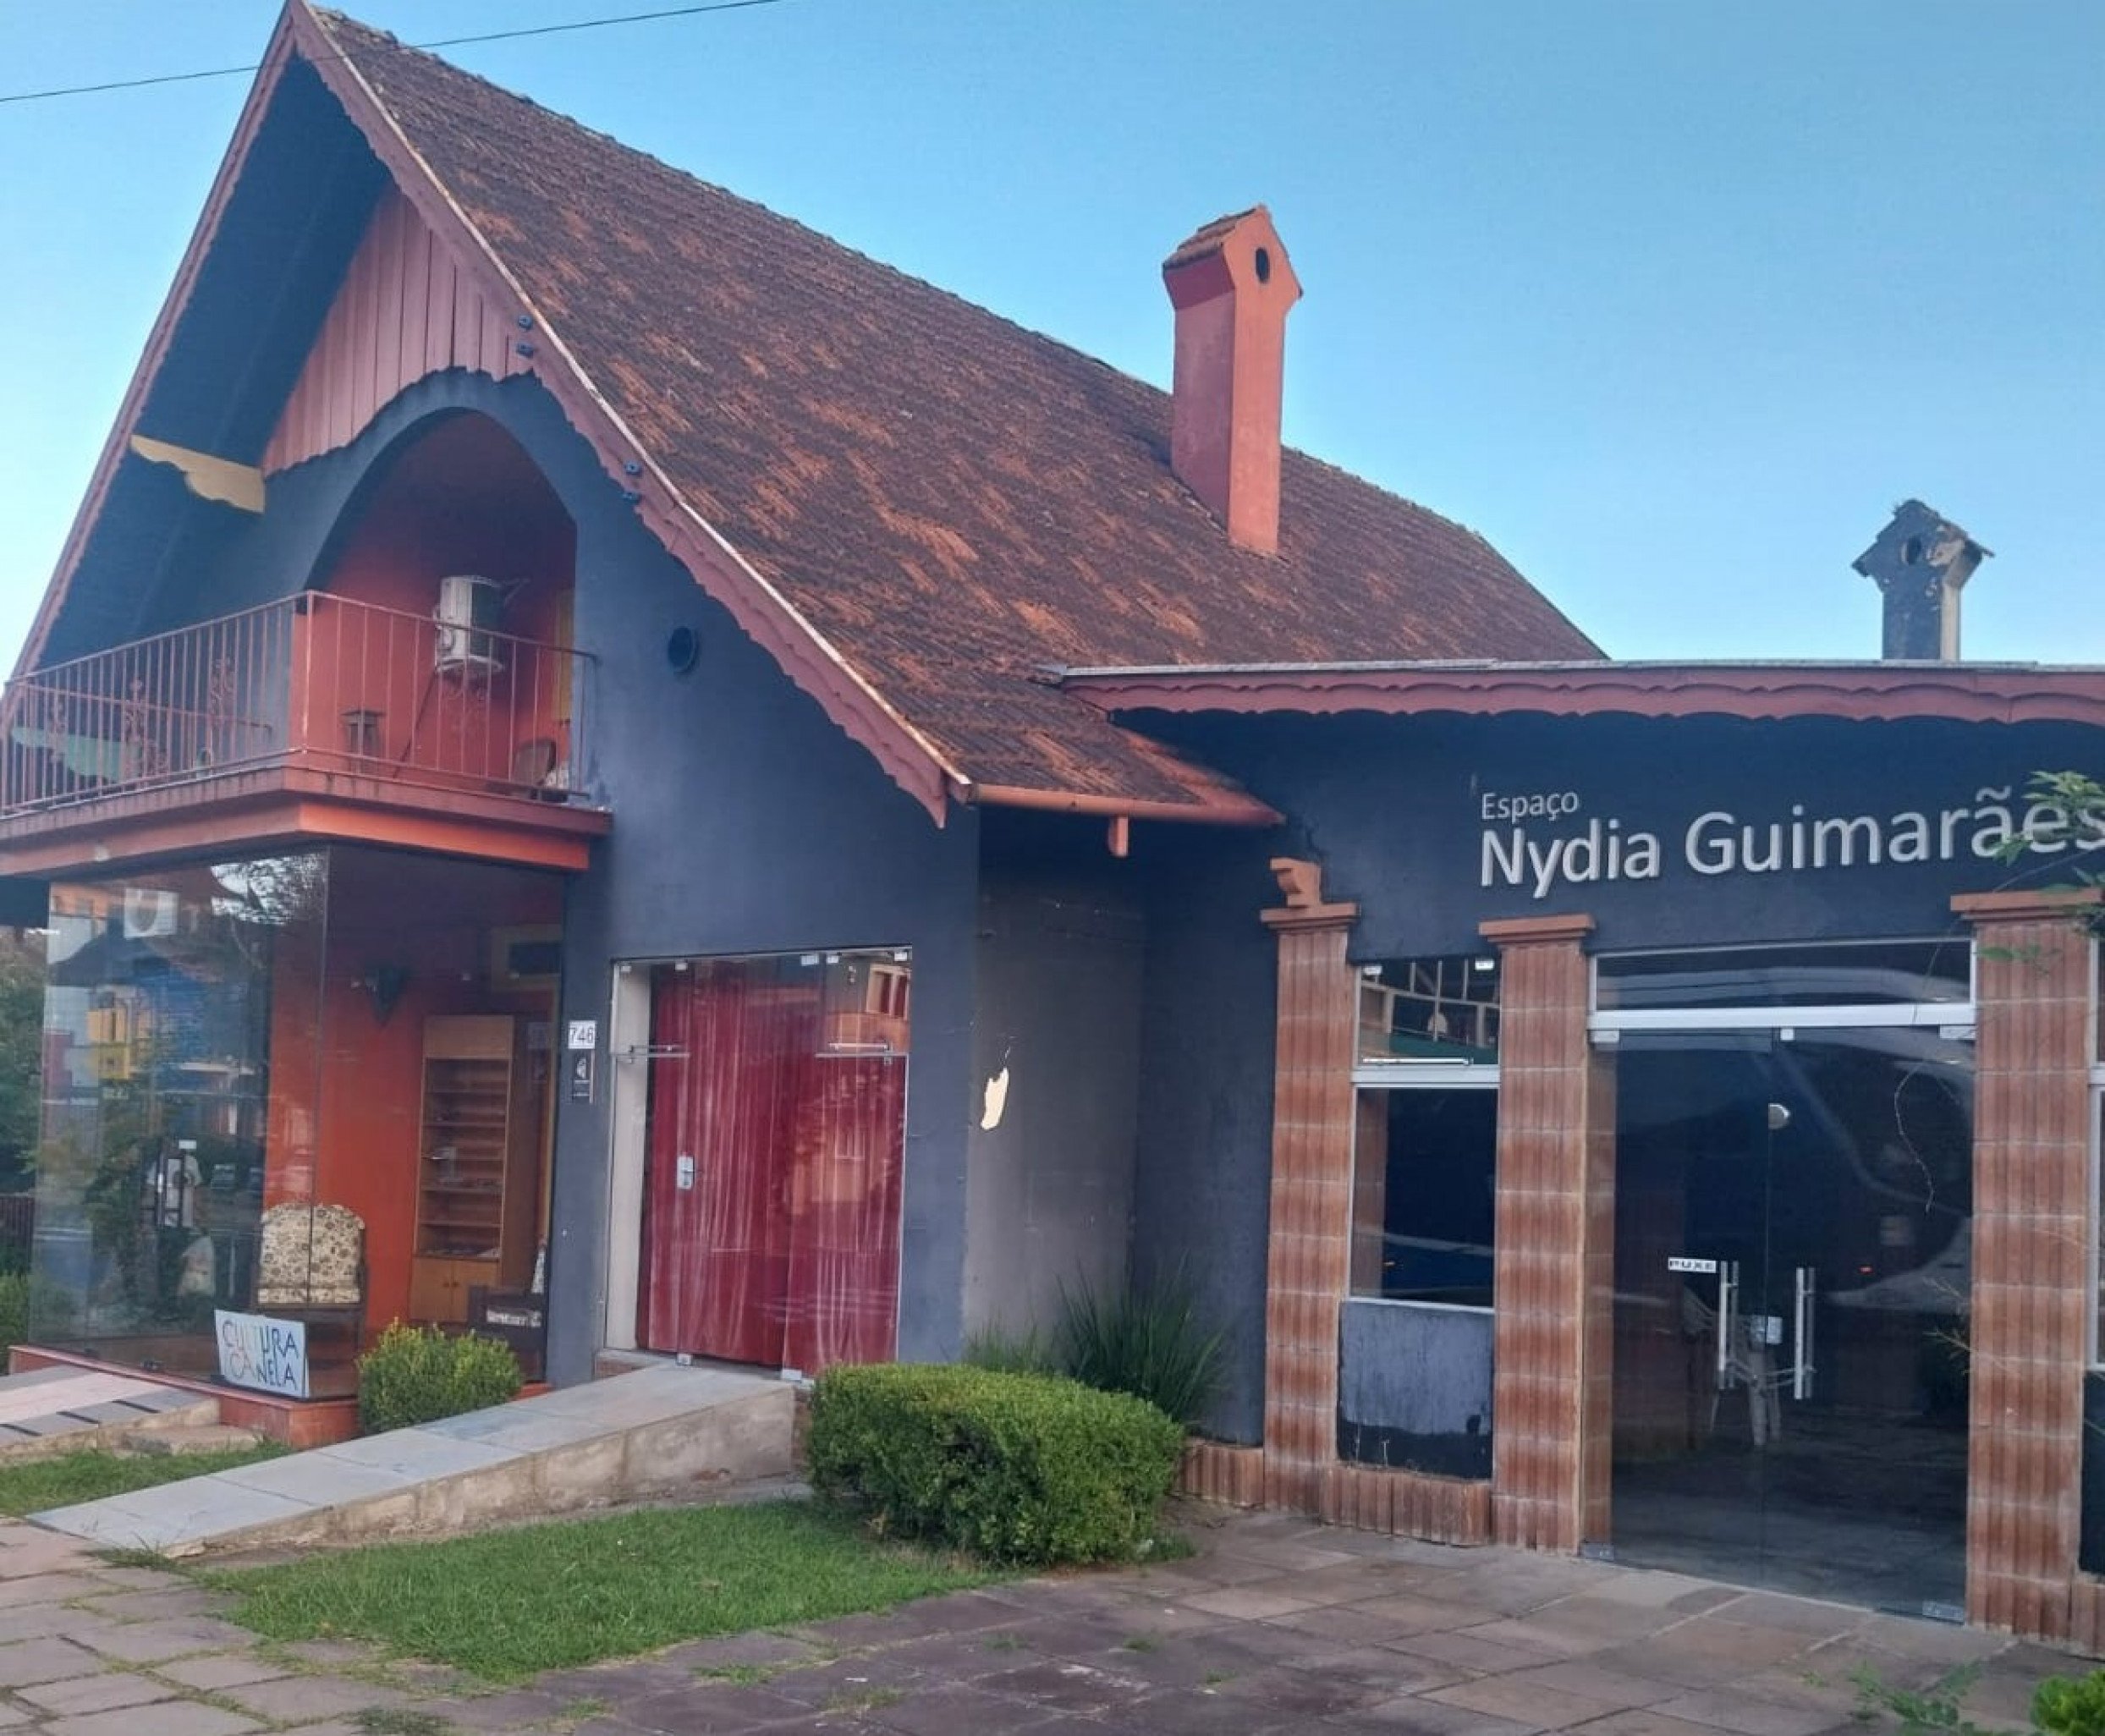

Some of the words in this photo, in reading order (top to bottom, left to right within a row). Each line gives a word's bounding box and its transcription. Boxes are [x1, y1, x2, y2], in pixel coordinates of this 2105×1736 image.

[1481, 792, 1580, 825] Espaço
[1480, 818, 1661, 899] Nydia
[1685, 785, 2105, 876] Guimarães
[569, 1026, 594, 1044] 746
[222, 1320, 300, 1360] CULTURA
[229, 1353, 298, 1391] CANELA
